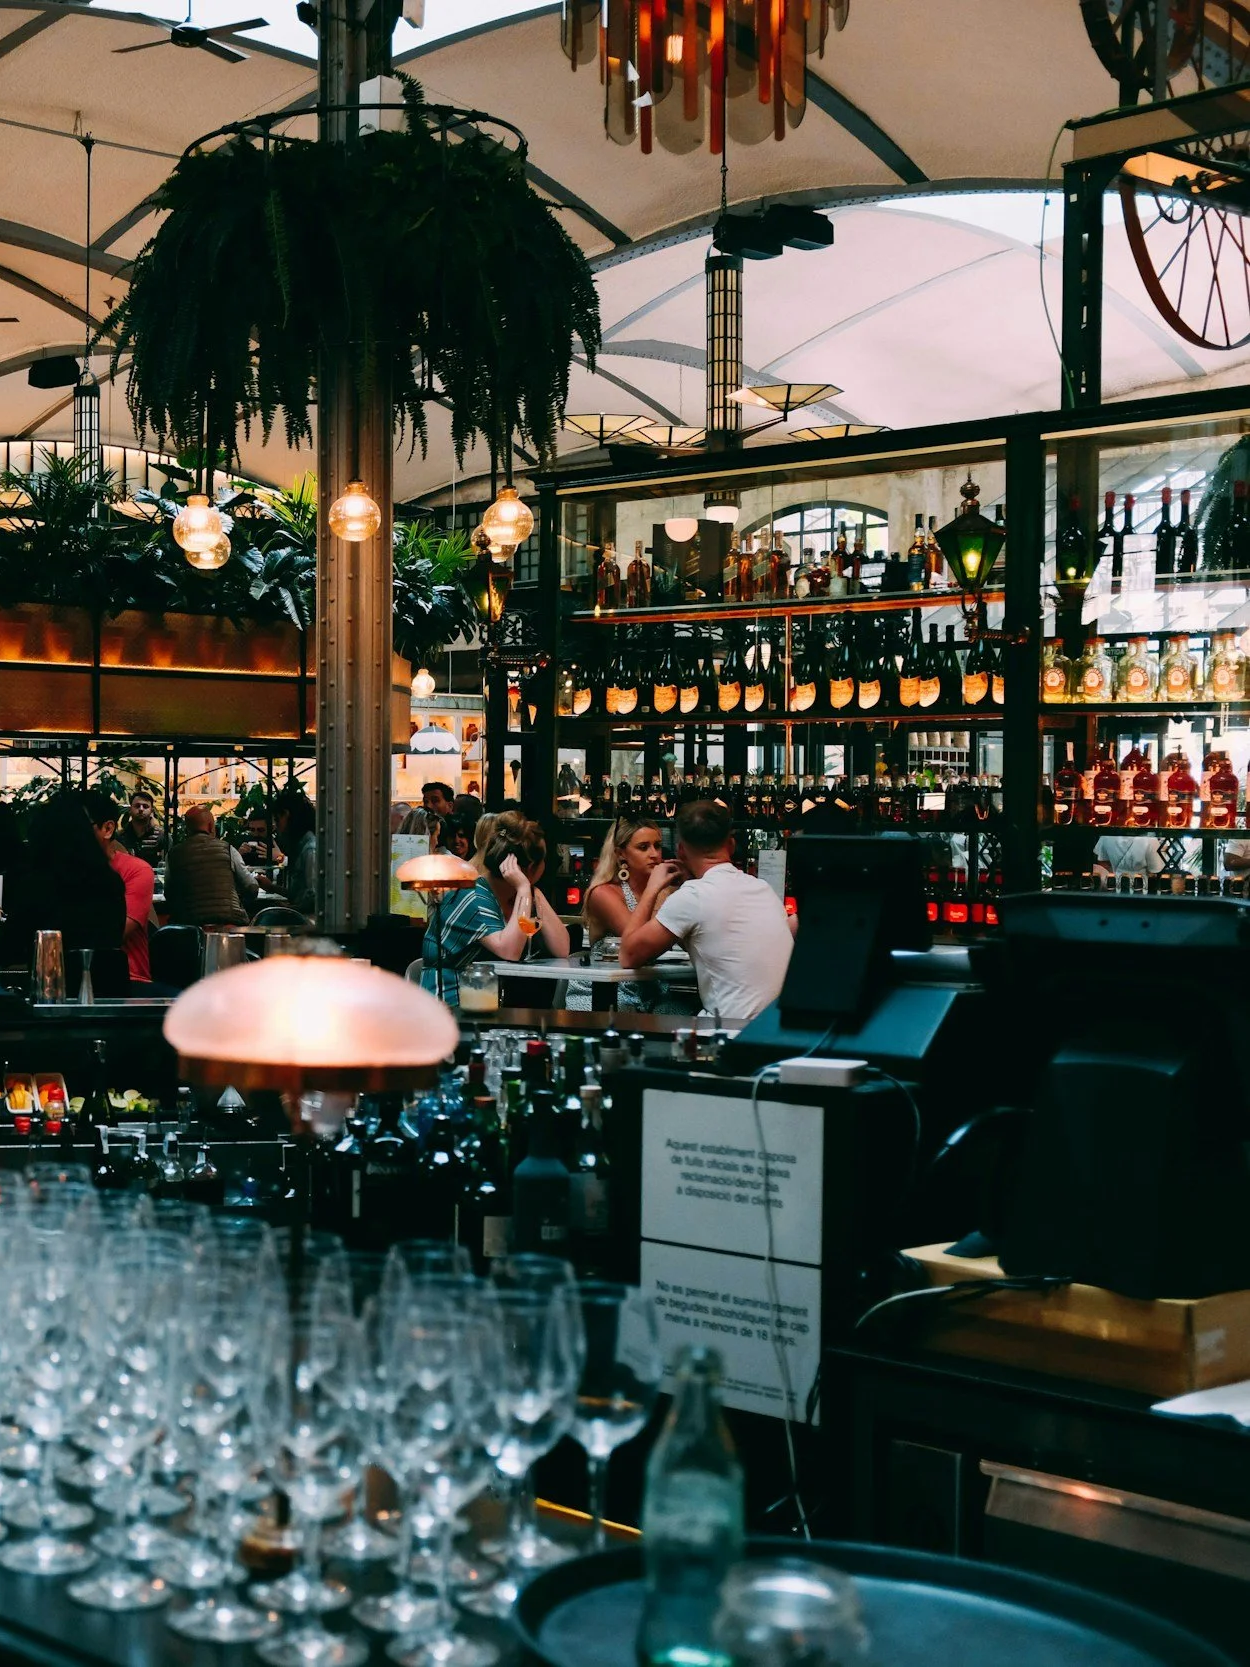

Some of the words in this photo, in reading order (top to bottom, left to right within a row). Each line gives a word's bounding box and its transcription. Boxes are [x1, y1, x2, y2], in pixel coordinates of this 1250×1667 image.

[665, 1139, 698, 1152] Aquest
[700, 1144, 755, 1159] establiment
[758, 1150, 797, 1164] dsposa
[671, 1154, 683, 1165] de
[684, 1155, 704, 1168] fulls
[706, 1159, 739, 1172] oficials
[741, 1164, 754, 1174] de
[757, 1166, 790, 1179] qeixa
[680, 1171, 779, 1193] reclamació/denúia
[751, 1195, 784, 1209] clints
[656, 1279, 670, 1292] No
[672, 1284, 683, 1295] es
[685, 1287, 719, 1301] permet
[721, 1293, 731, 1303] el
[733, 1296, 808, 1318] suminisrament
[655, 1296, 667, 1306] de
[669, 1298, 710, 1314] begudes
[775, 1318, 788, 1329] de
[790, 1322, 810, 1336] cap
[664, 1313, 691, 1326] mena
[701, 1320, 738, 1336] menors
[740, 1326, 753, 1338] de
[756, 1329, 768, 1341] 18
